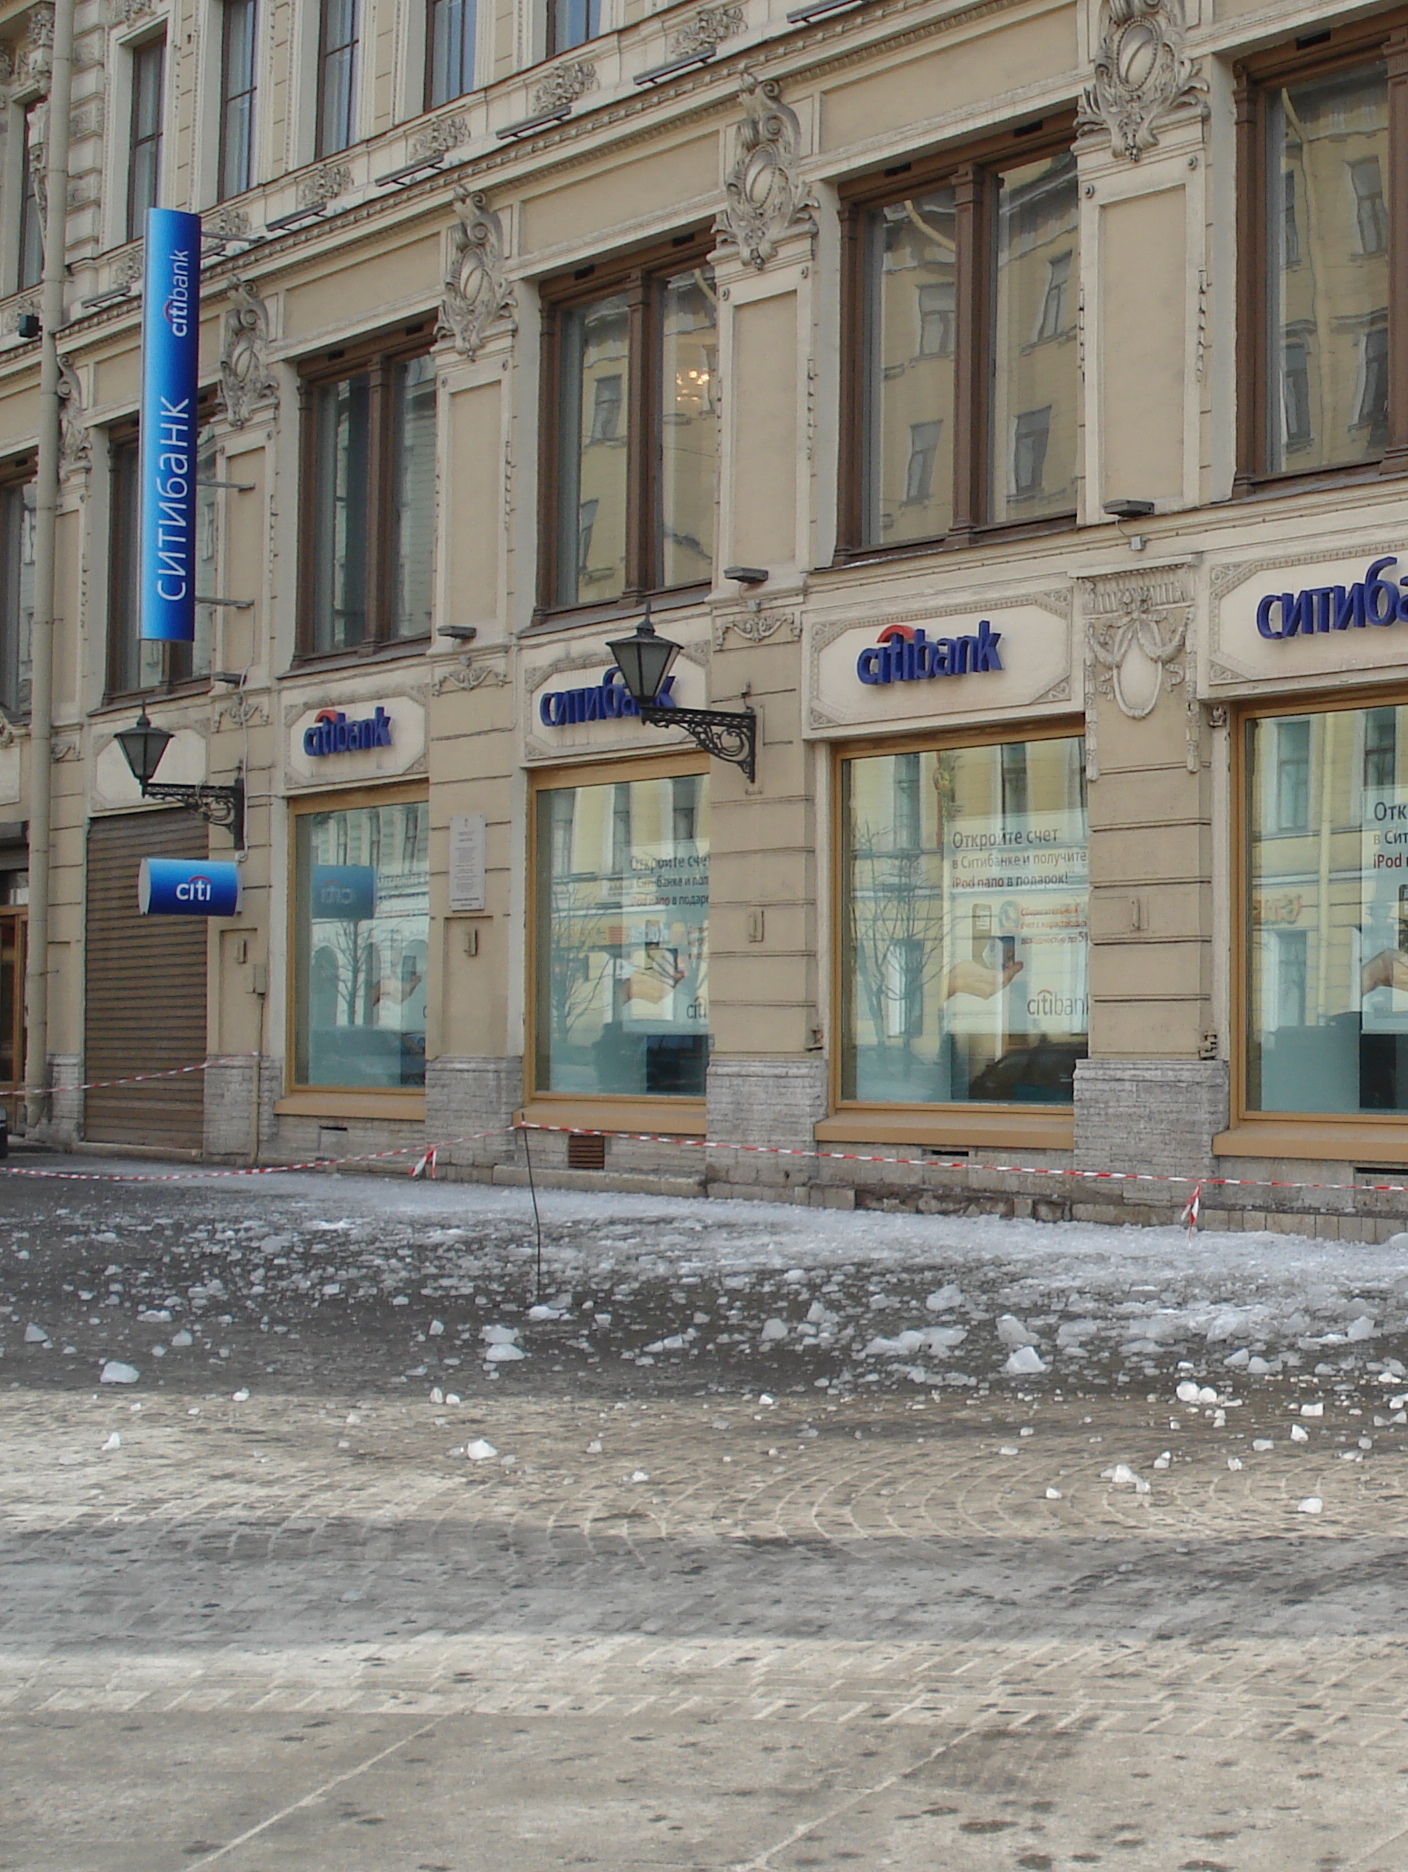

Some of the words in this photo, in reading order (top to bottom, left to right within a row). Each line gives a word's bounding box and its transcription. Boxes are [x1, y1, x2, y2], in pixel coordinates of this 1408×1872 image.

[164, 249, 190, 337] citibank
[157, 396, 190, 602] ситибанк
[857, 620, 1003, 685] citibank
[539, 666, 677, 727] ситибак
[303, 706, 392, 756] citibank
[952, 829, 1023, 851] Откройте
[960, 853, 1021, 869] Ситибанке
[1373, 852, 1402, 869] iPod
[176, 875, 212, 901] citi
[1007, 878, 1013, 887] в
